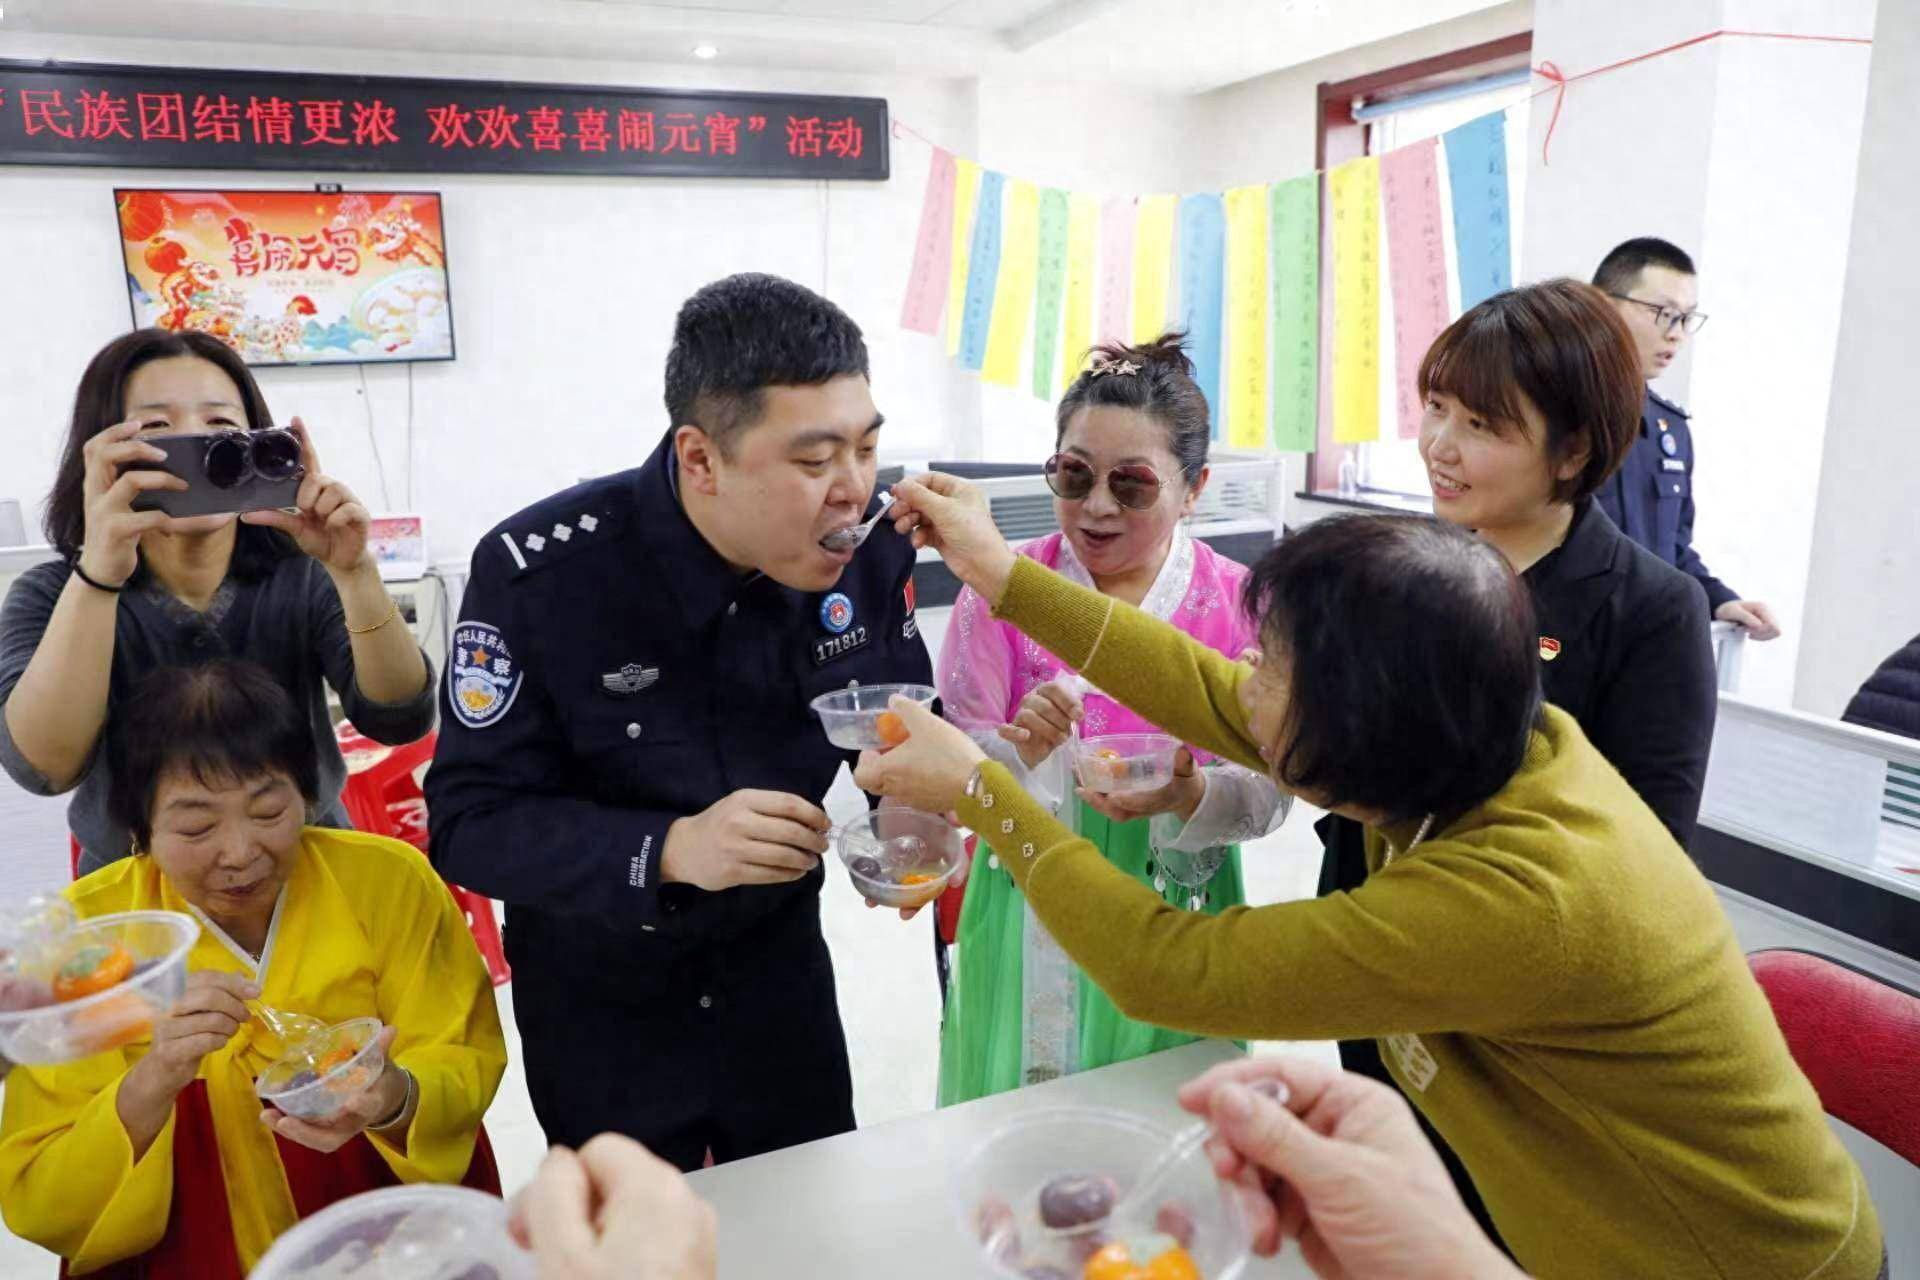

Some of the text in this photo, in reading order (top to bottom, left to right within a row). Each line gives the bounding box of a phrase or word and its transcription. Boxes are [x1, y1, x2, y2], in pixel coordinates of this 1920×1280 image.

[426, 103, 766, 154] 欢欢喜喜闹元宵”
[785, 115, 863, 158] 活动
[224, 218, 361, 277] 喜闹元宵
[816, 626, 867, 660] 171812
[629, 856, 640, 886] CHINA
[637, 835, 652, 888] IMMIGRATION
